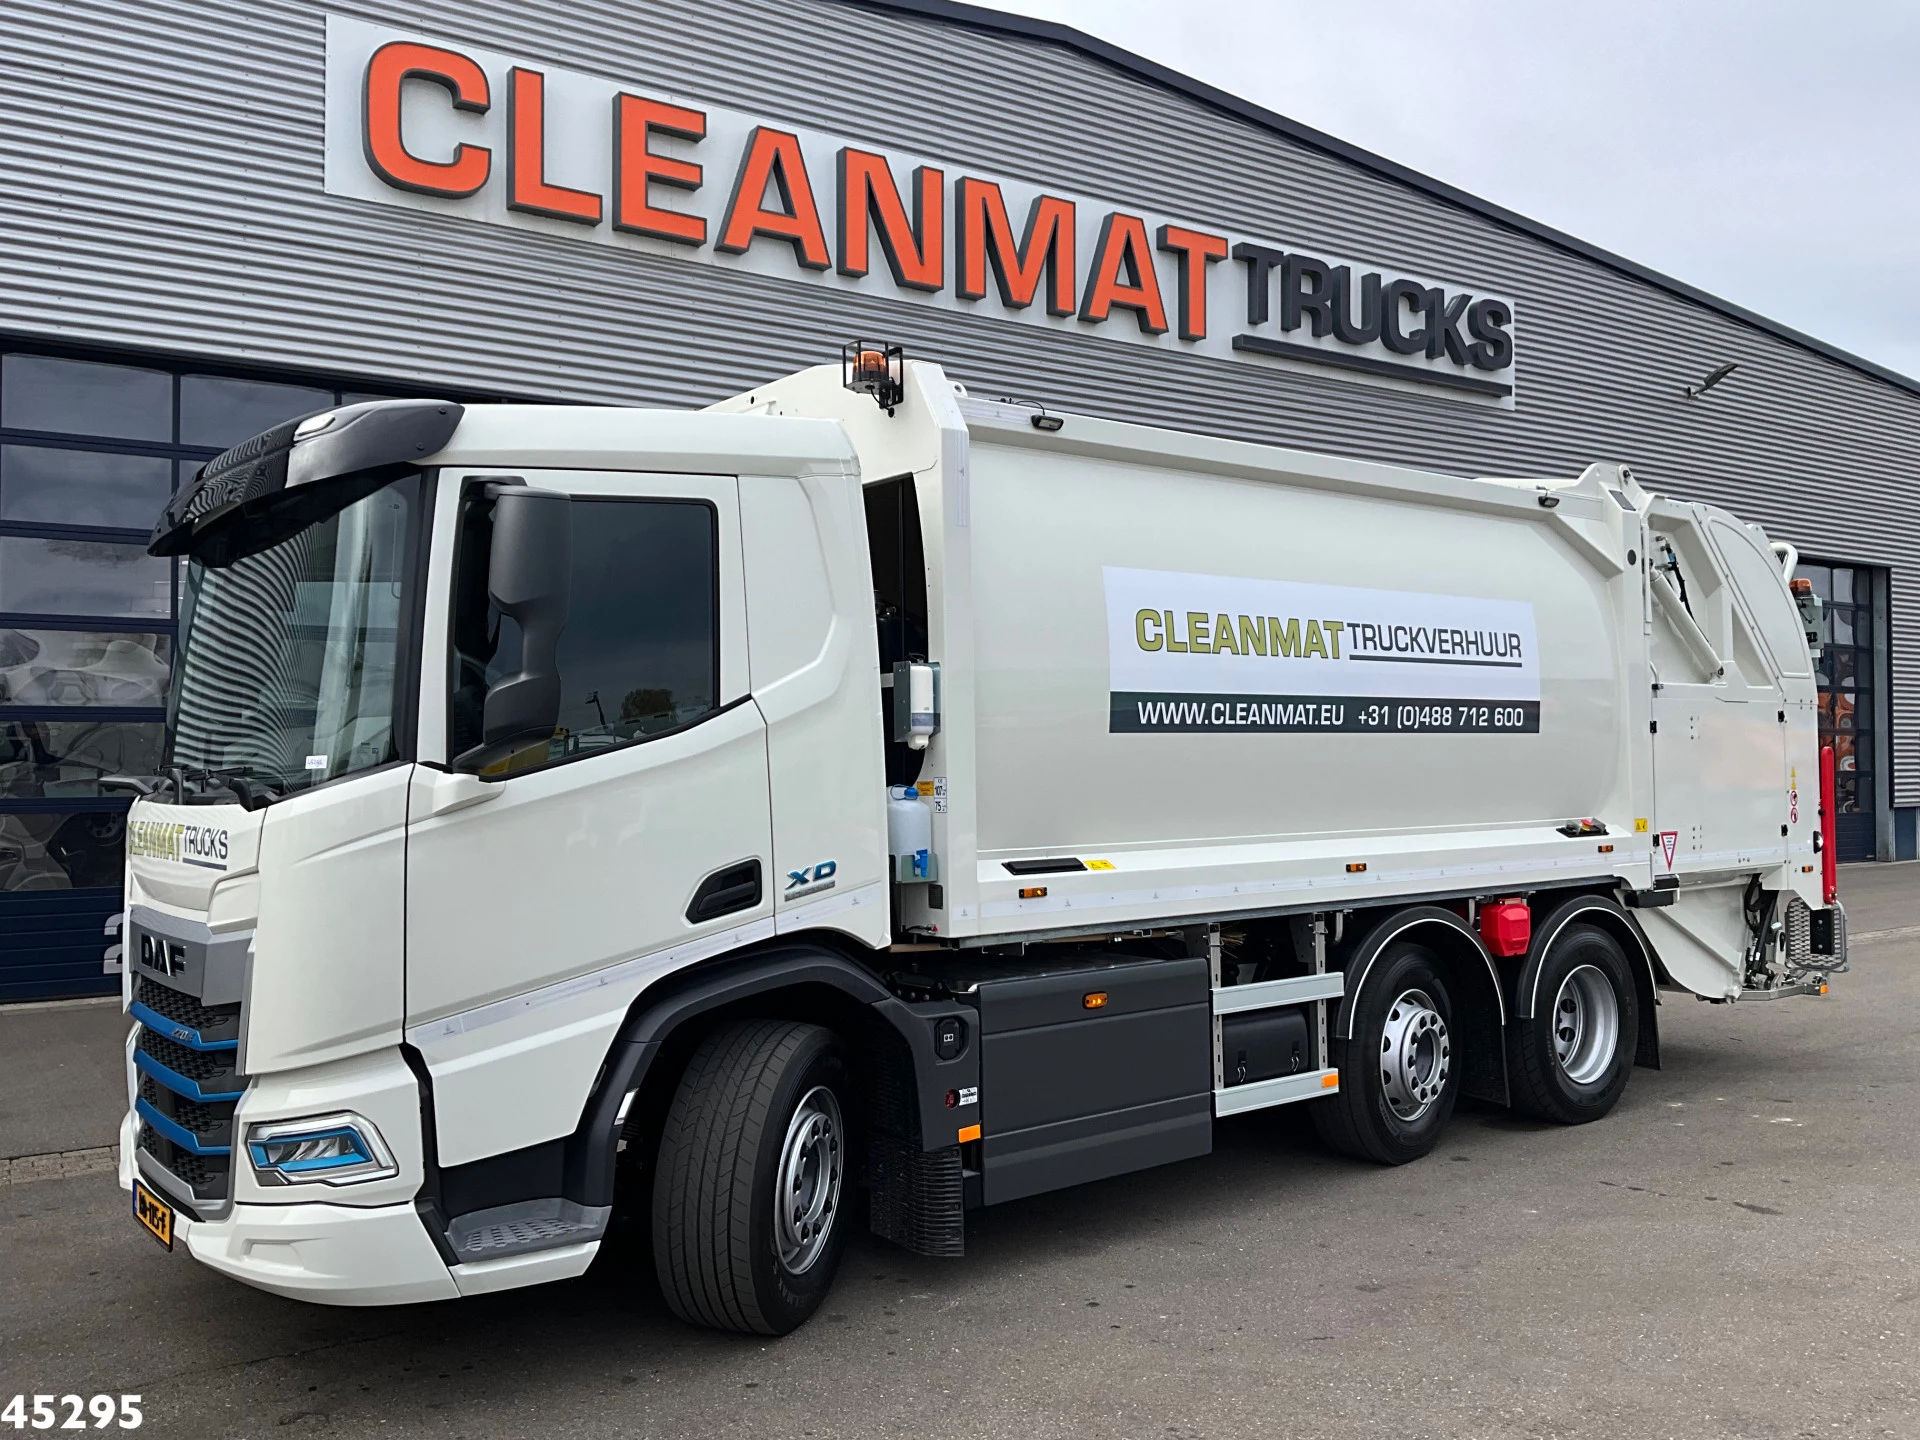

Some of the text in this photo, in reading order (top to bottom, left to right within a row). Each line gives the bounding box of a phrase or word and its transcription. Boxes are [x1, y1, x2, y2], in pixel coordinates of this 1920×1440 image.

[362, 40, 1512, 371] CLEANMAT TRUCKS
[1135, 608, 1522, 659] CLEANMAT TRUCKVERHUUR
[1137, 701, 1524, 729] WWW.CLEANMAT.EU +31 (0)488 712 600
[184, 825, 228, 860] TRUCKS
[784, 859, 837, 890] XD
[141, 932, 187, 979] DAF
